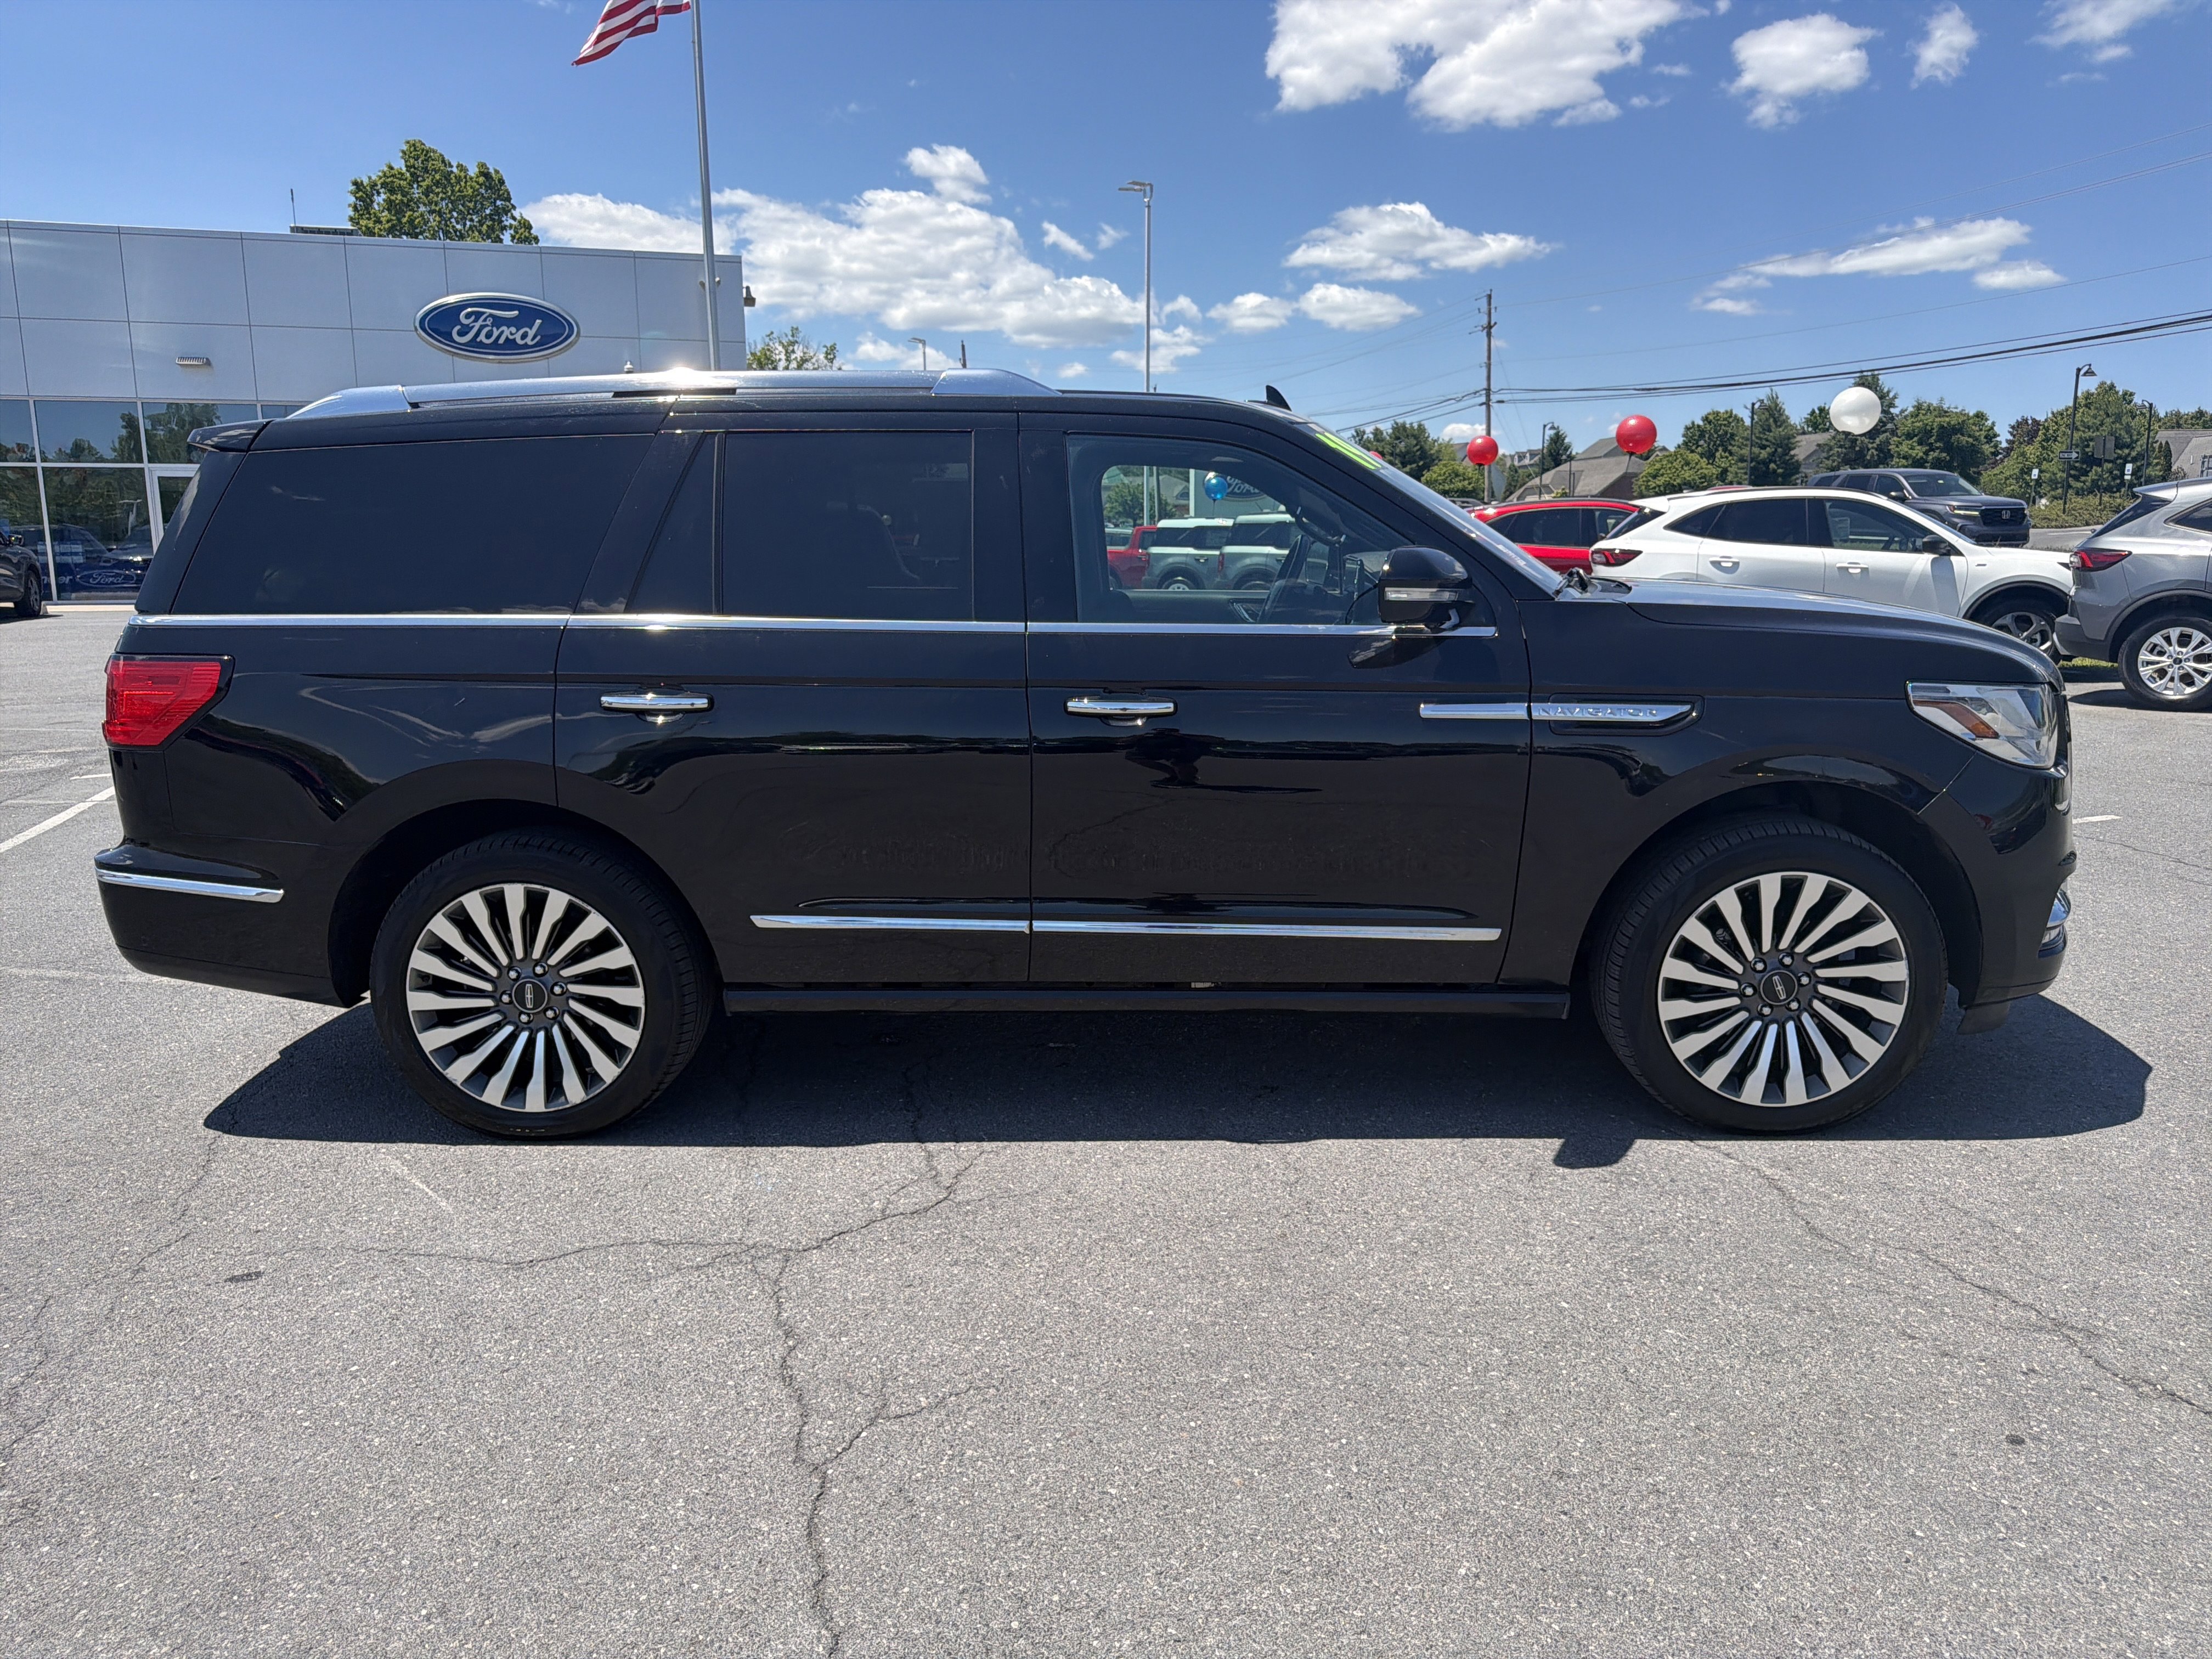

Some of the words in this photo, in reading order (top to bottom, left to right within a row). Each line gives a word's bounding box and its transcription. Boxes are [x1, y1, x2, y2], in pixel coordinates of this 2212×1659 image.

[452, 308, 542, 345] Ford
[90, 572, 123, 584] Ford
[1538, 706, 1657, 717] NAVIGATOR
